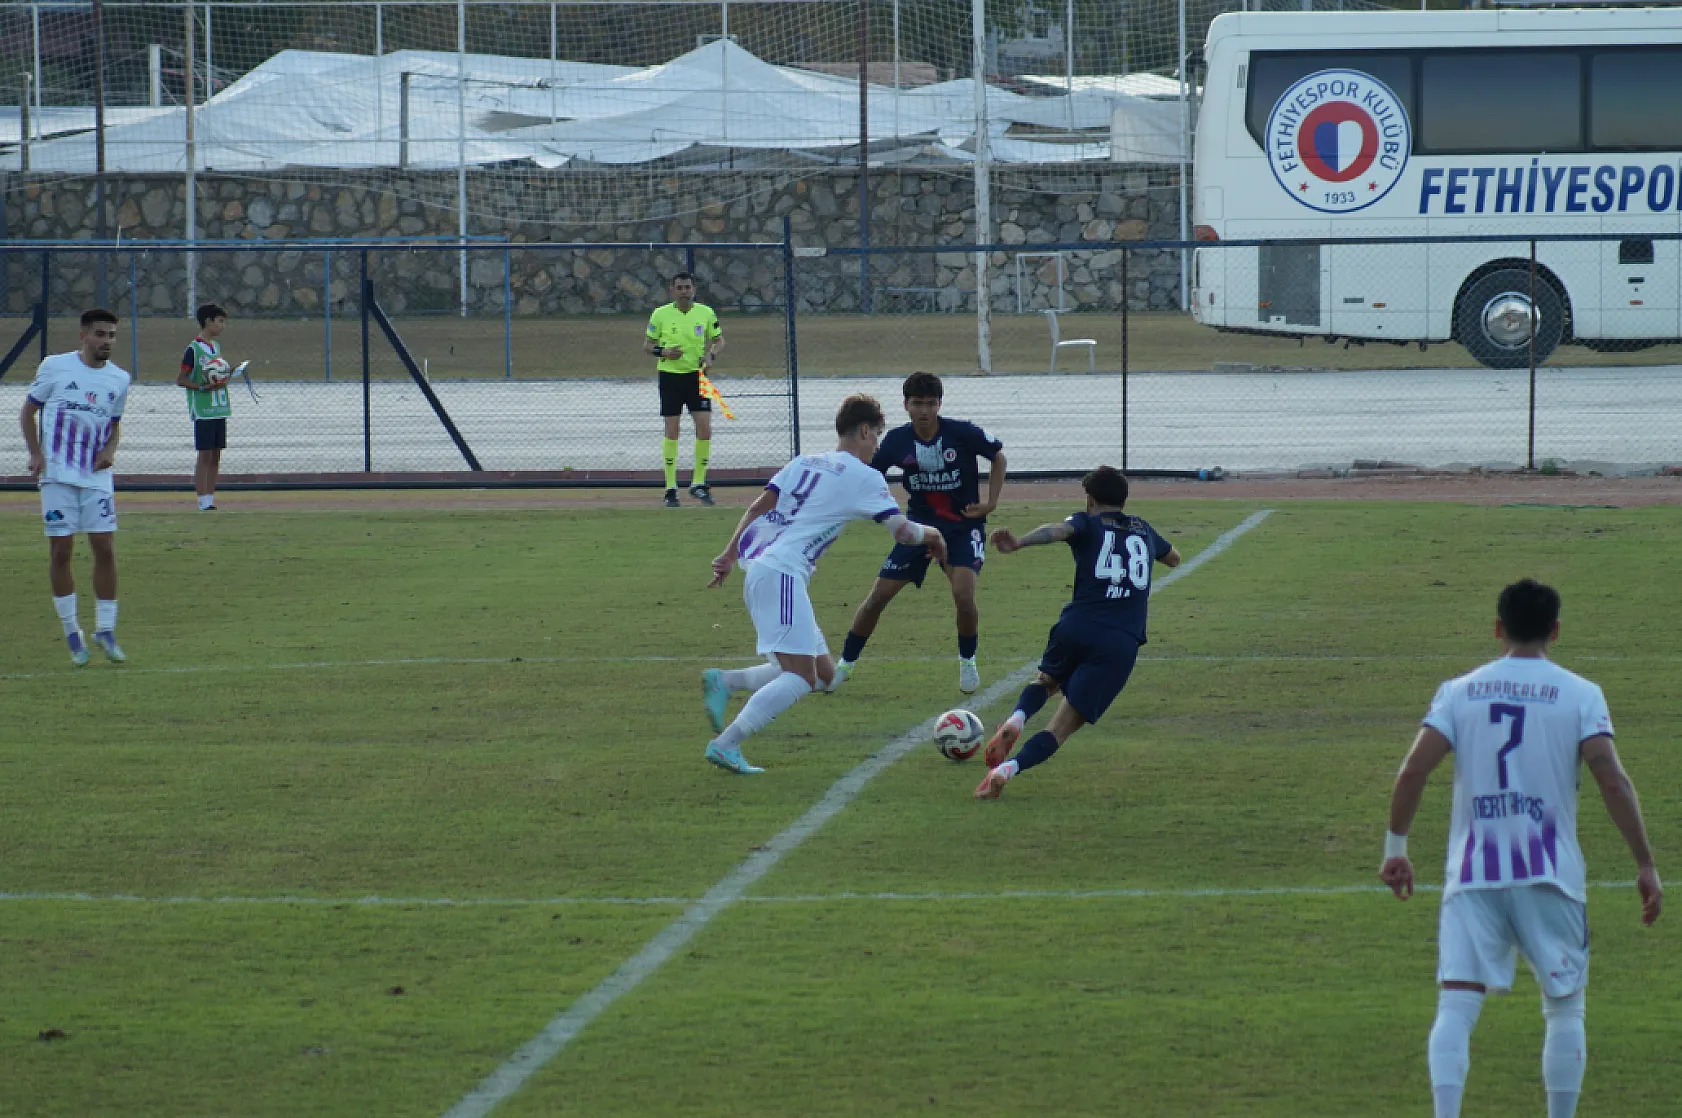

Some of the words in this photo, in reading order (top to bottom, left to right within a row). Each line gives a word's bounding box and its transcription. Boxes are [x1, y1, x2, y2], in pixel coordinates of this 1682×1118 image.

[1277, 79, 1359, 173] FETHİYESPOR
[1362, 89, 1404, 171] KULÜBÜ
[1324, 191, 1357, 205] 1933
[1418, 157, 1682, 214] FETHİYESPO
[790, 469, 822, 516] 4
[908, 469, 961, 485] ESNAF
[1094, 530, 1149, 591] 48
[1489, 702, 1526, 790] 7
